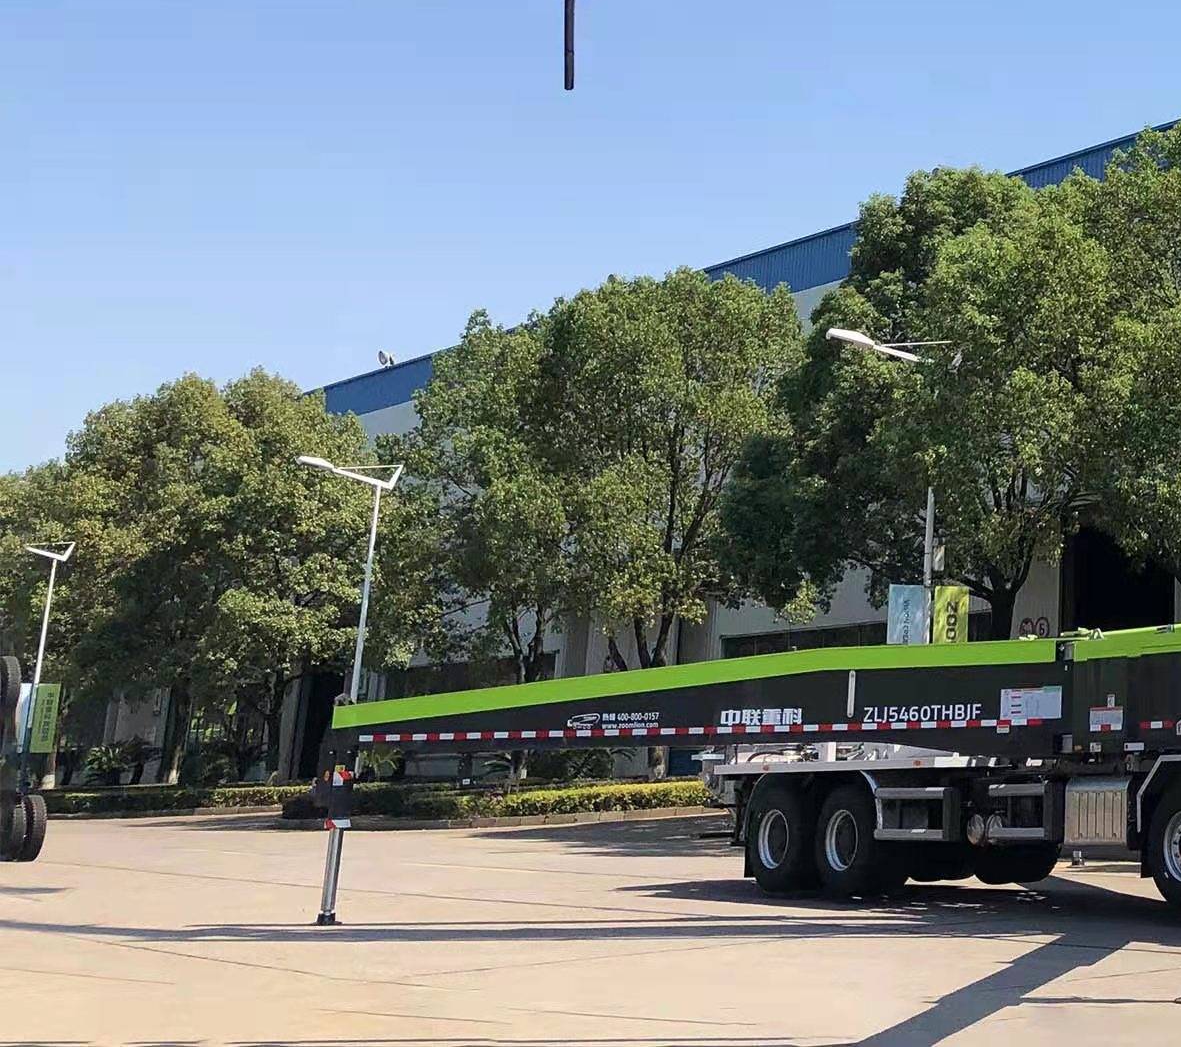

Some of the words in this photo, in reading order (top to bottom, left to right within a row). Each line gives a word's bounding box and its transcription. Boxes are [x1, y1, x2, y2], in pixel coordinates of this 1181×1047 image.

[945, 601, 958, 643] ZOO
[617, 712, 660, 722] 400-800-0157
[720, 708, 802, 726] 中联重科
[863, 704, 982, 723] ZLJ5460THBJF
[601, 722, 659, 730] www.zoomlion.com
